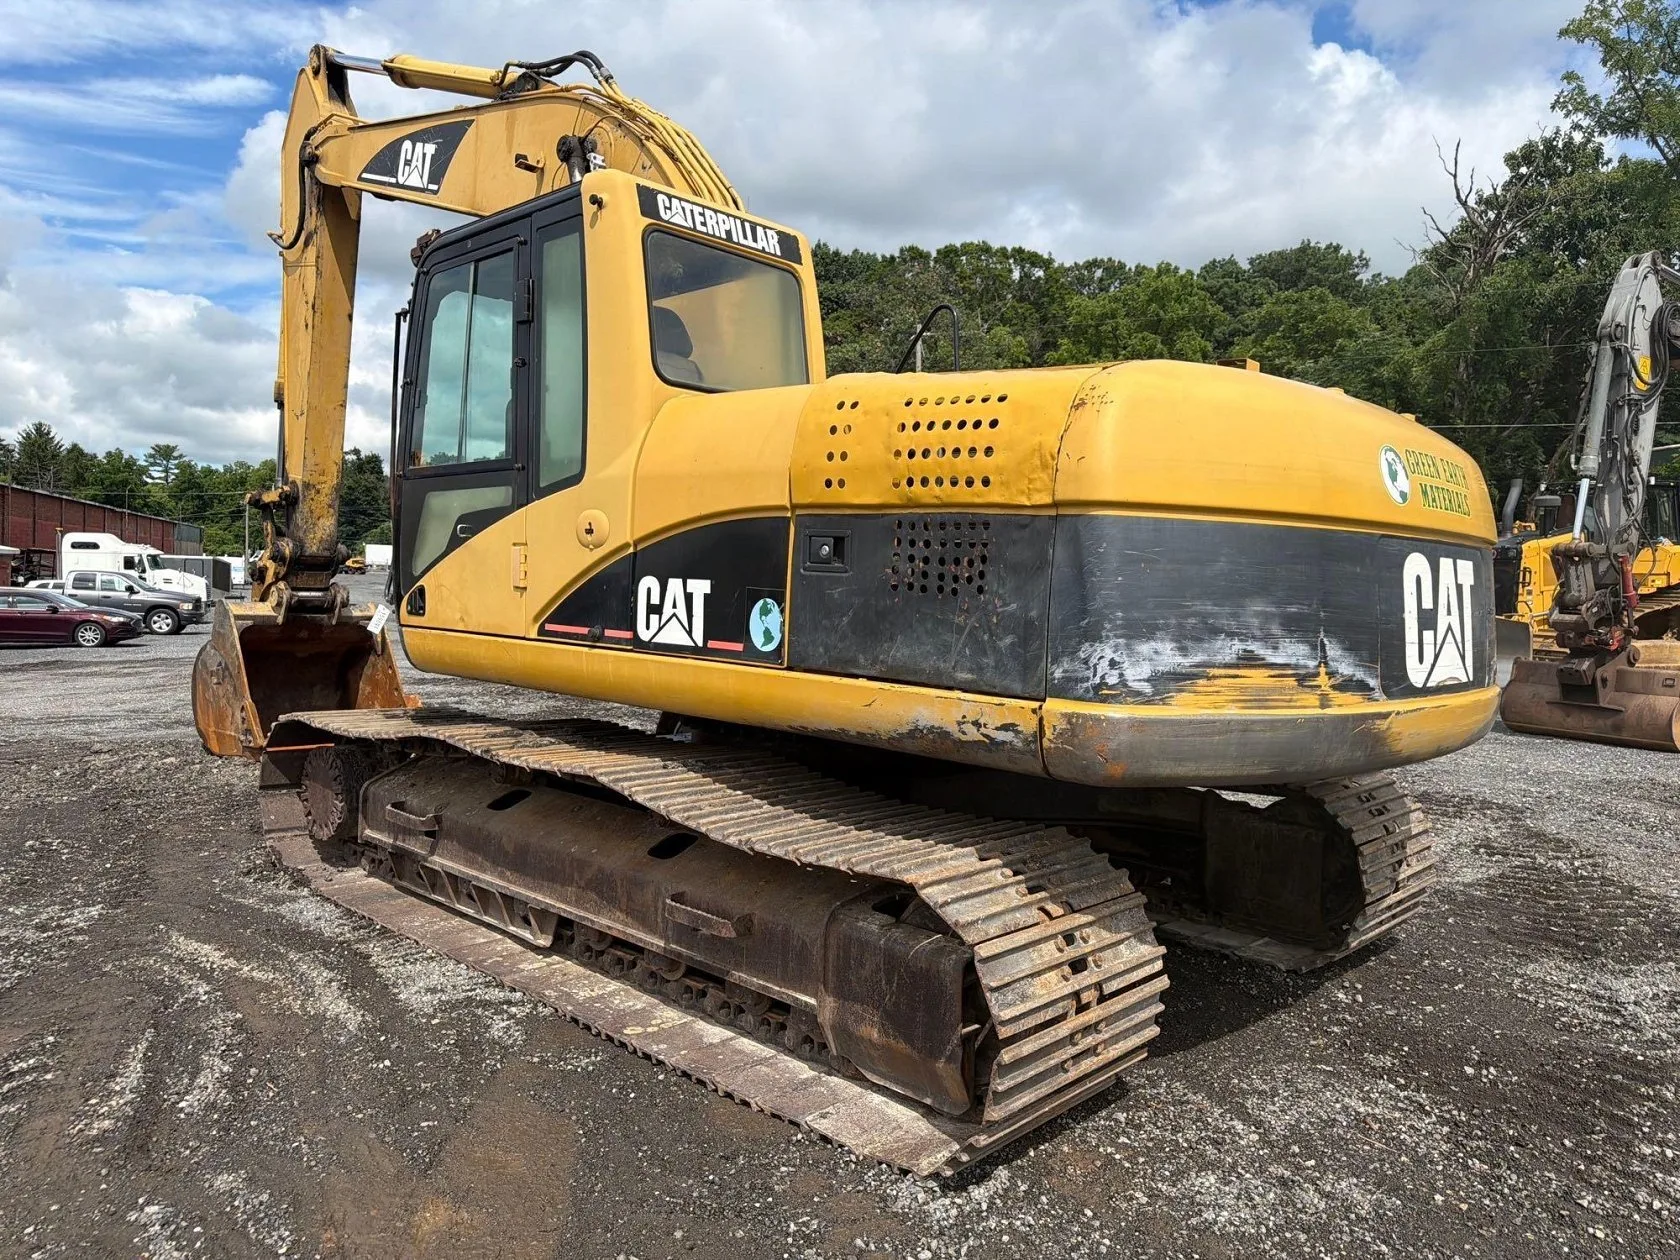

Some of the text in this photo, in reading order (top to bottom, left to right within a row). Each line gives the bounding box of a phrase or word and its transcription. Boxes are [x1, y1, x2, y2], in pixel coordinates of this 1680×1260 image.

[398, 140, 437, 189] CAT
[656, 193, 782, 256] CATERPILLAR
[1405, 448, 1470, 491] GREEN EARTH
[1418, 482, 1471, 517] MATERIALS
[636, 575, 712, 647] CAT
[1403, 551, 1475, 688] CAT
